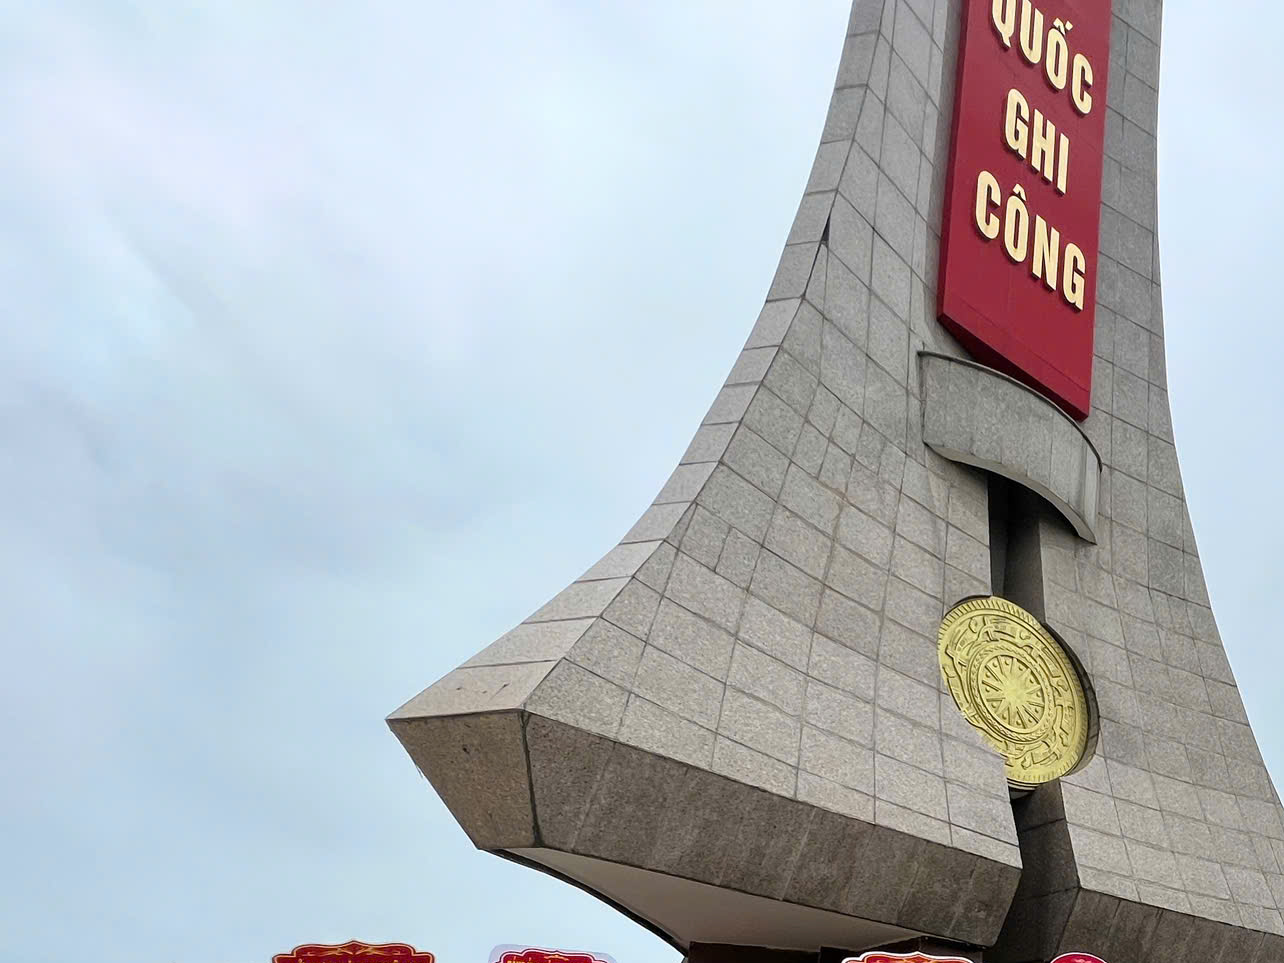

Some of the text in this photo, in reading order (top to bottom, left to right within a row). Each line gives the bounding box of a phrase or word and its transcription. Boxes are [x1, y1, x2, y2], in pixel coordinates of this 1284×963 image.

[991, 0, 1093, 115] QUỐC
[1005, 88, 1070, 195] GHI
[975, 170, 1086, 312] CÔNG
